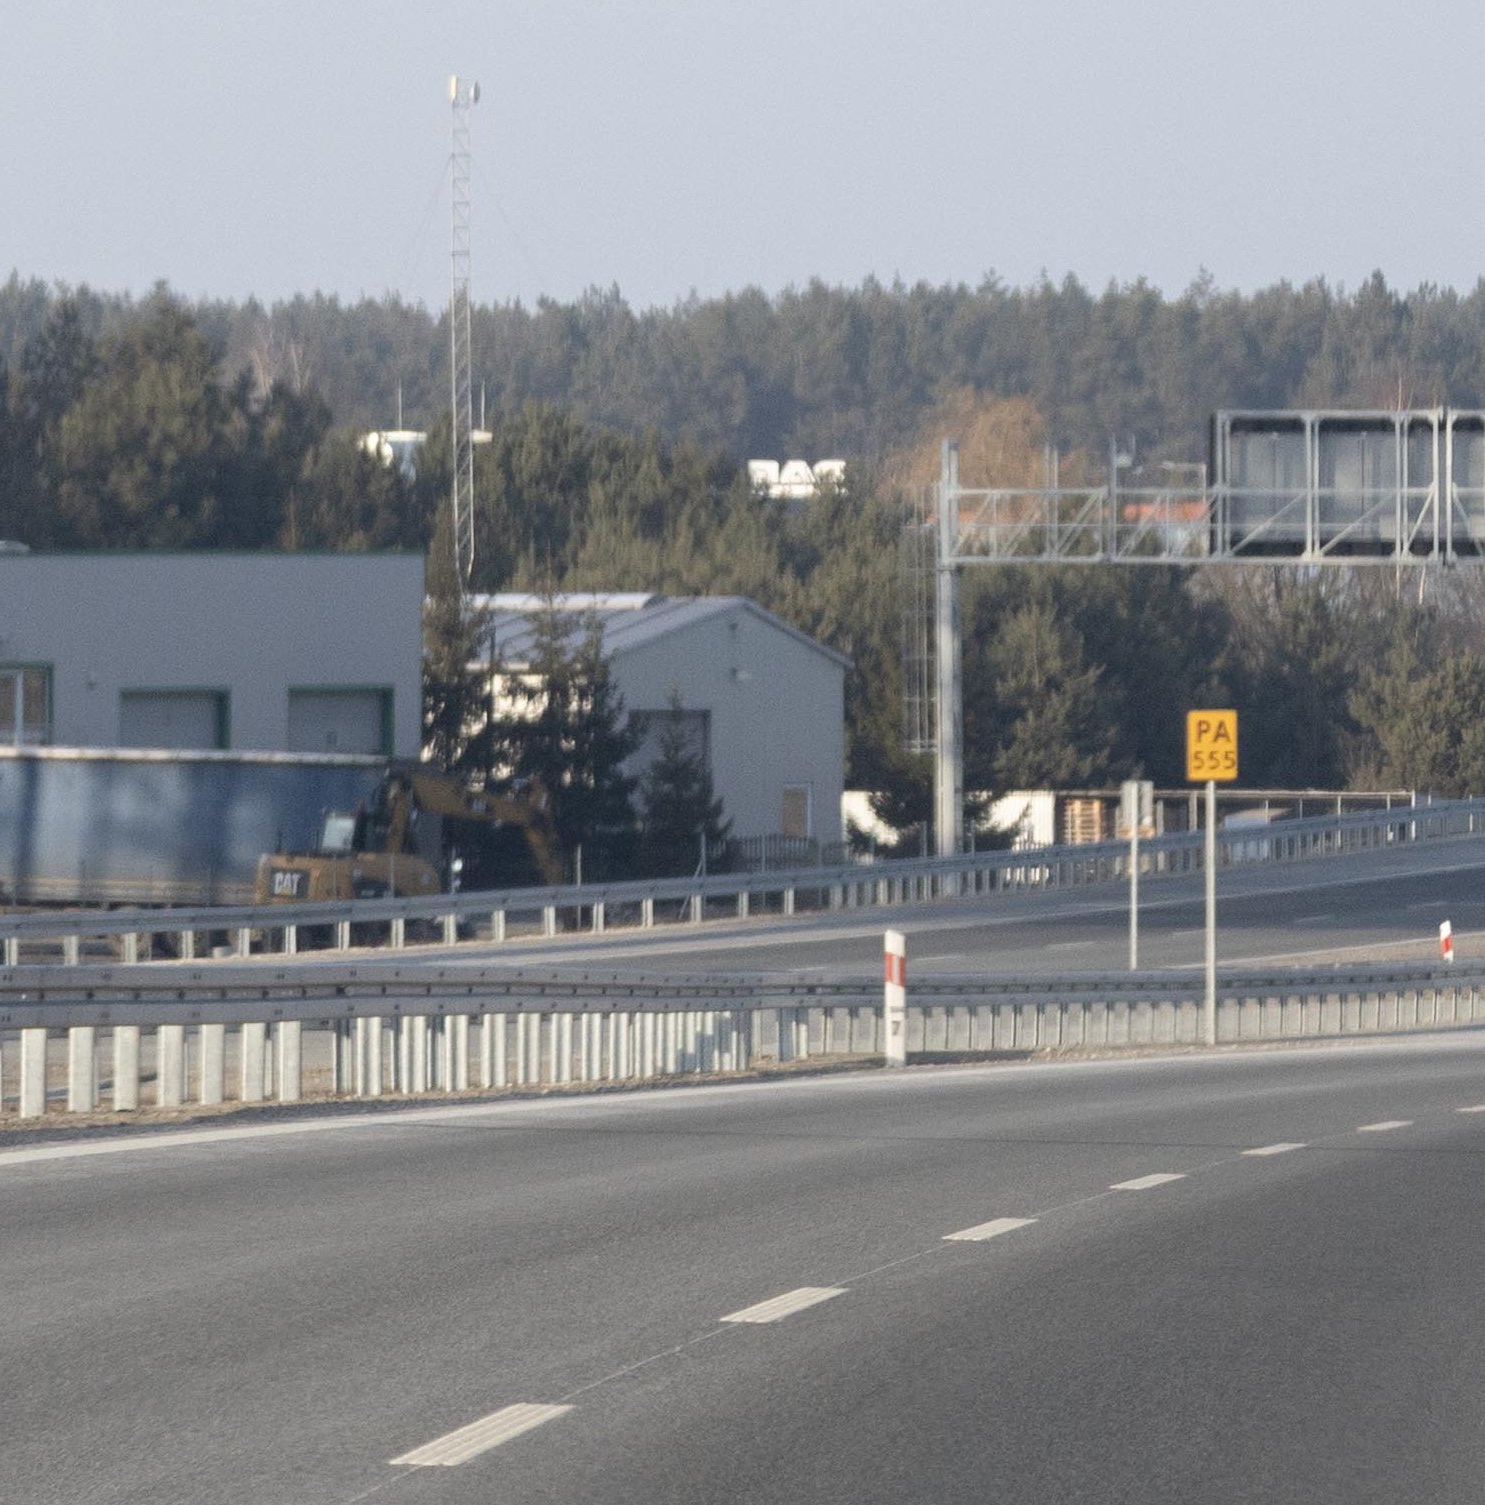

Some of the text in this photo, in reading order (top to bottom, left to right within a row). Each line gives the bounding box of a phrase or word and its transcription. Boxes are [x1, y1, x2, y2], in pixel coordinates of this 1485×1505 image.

[1196, 719, 1231, 743] PA
[1193, 751, 1236, 770] 555
[274, 872, 301, 896] CAT
